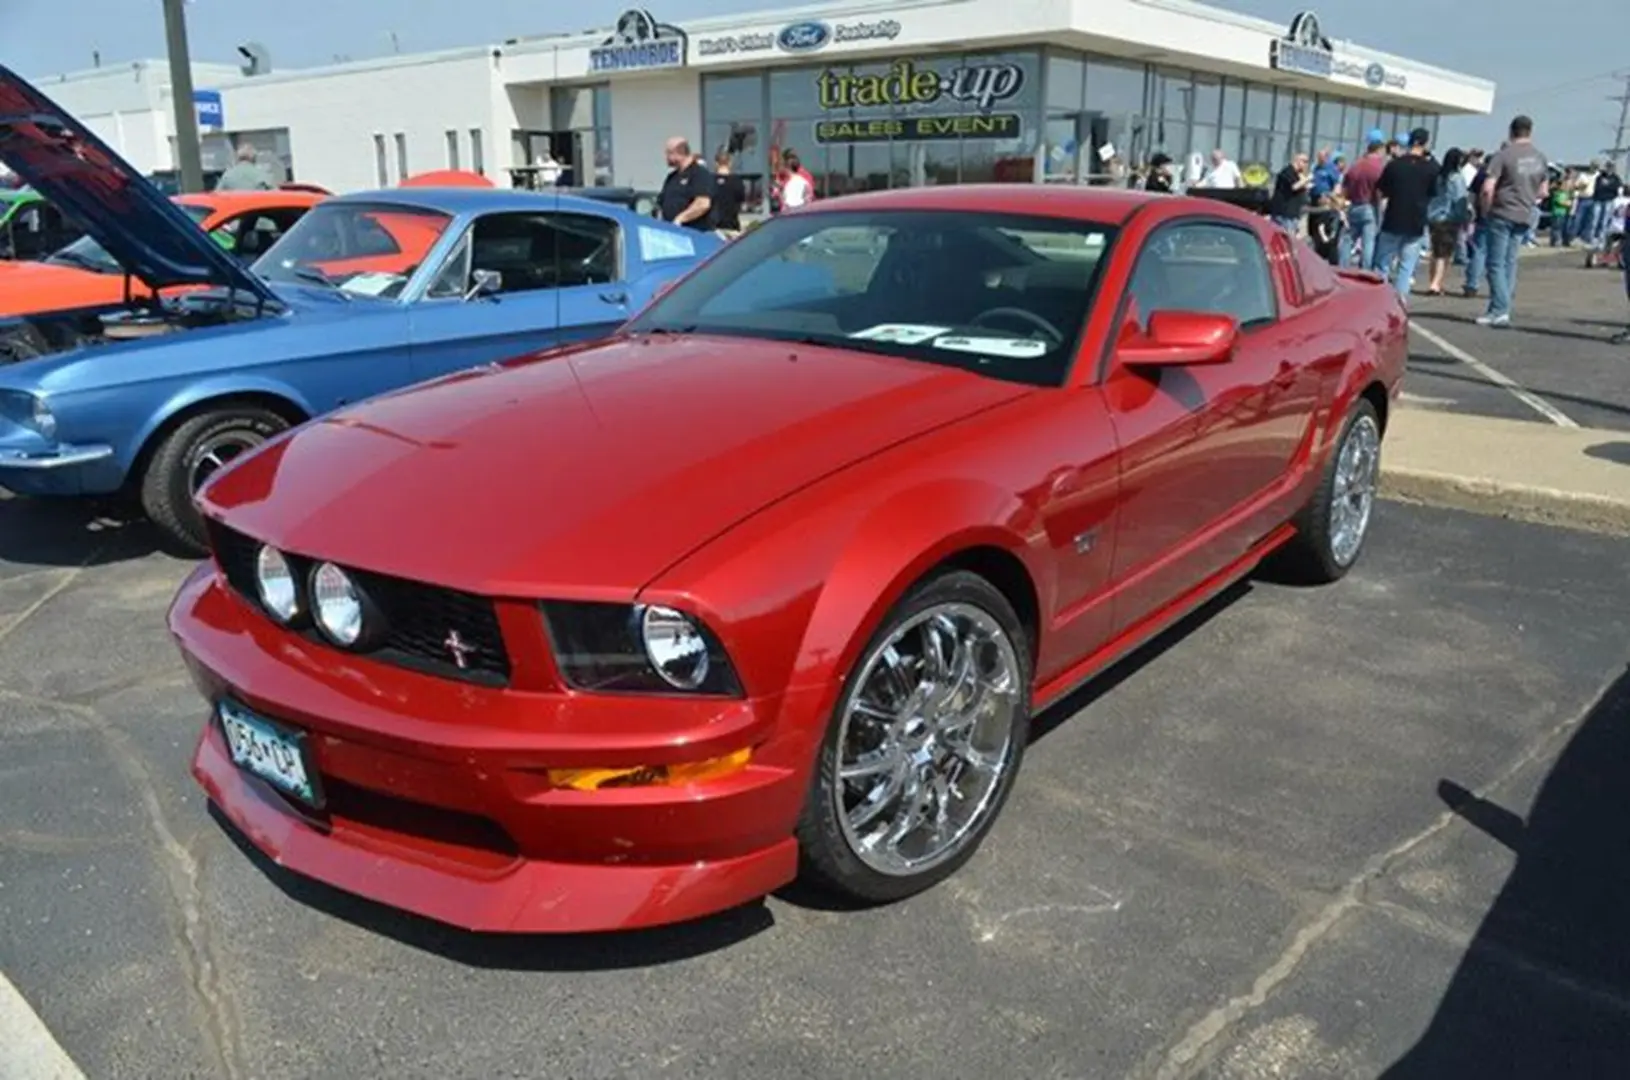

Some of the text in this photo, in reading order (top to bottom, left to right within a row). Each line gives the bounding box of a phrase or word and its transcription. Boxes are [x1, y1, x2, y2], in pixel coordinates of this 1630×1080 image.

[786, 24, 820, 48] Ford
[834, 19, 902, 43] Dealership
[818, 115, 1014, 139] SALES EVENT
